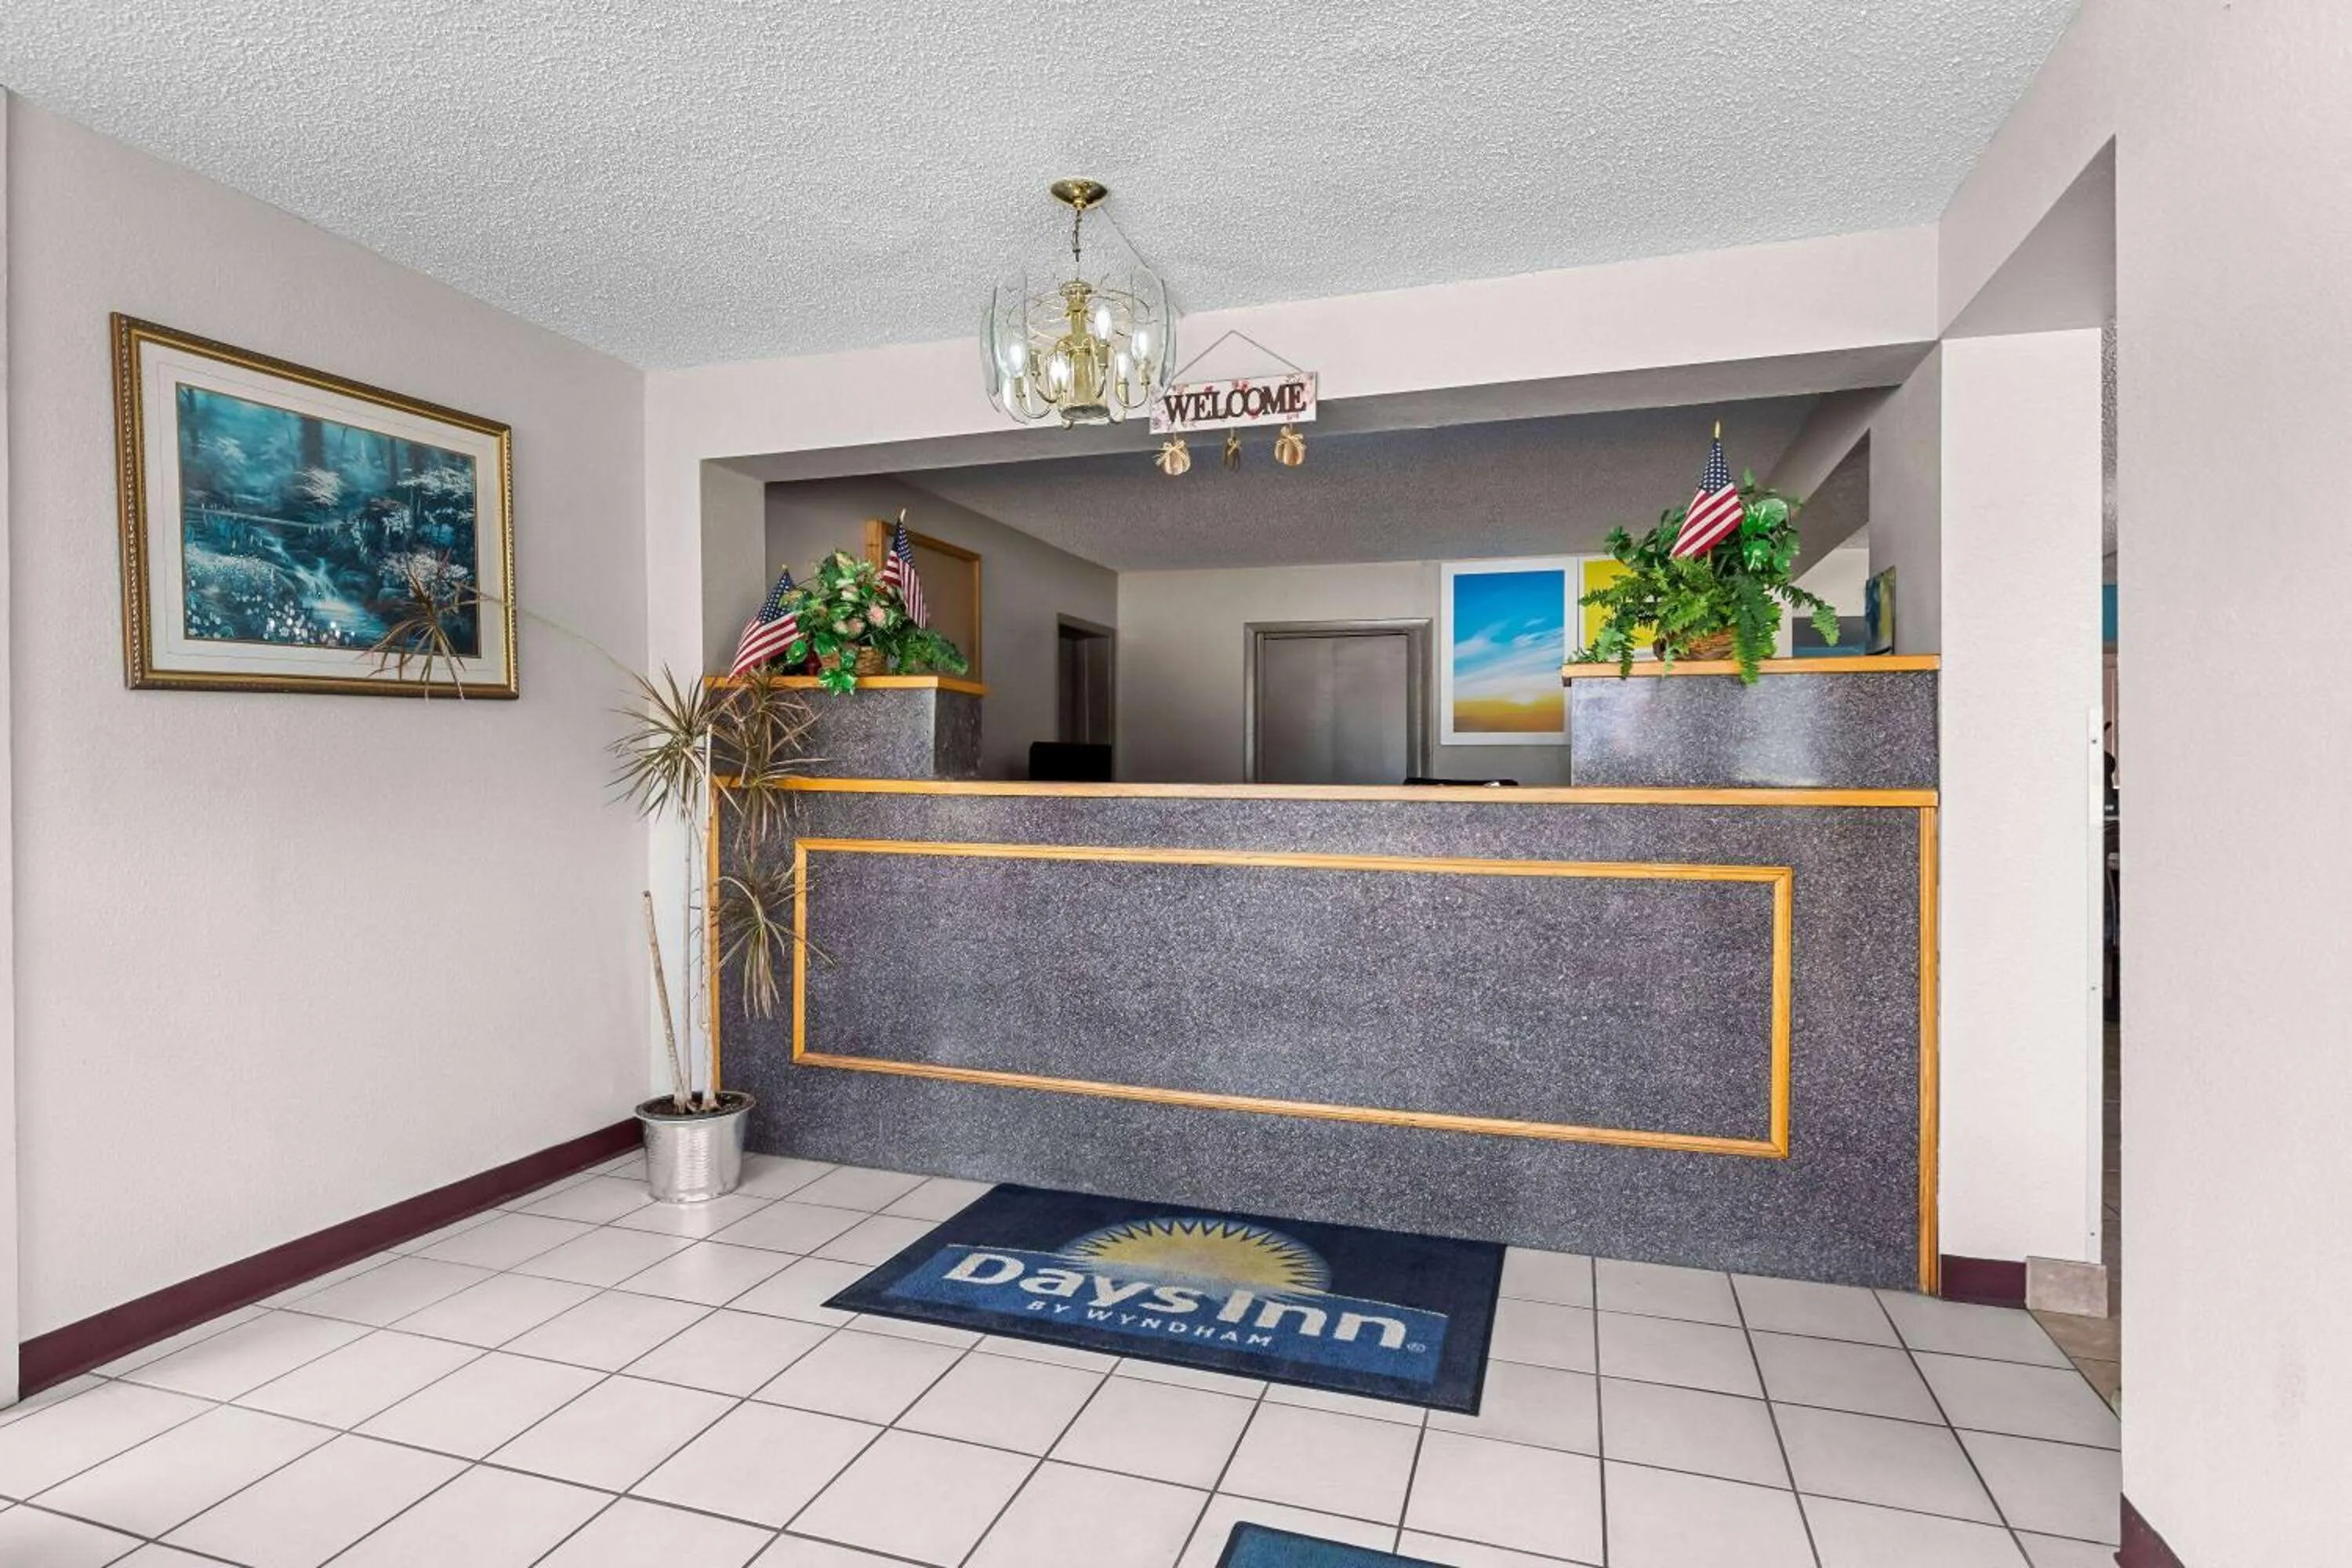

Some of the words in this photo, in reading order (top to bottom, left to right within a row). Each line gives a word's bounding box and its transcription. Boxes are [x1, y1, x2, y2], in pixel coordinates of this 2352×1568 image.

[1163, 383, 1307, 424] WELCOME
[941, 1253, 1204, 1313] Days
[1216, 1290, 1407, 1349] Inn
[1025, 1301, 1072, 1314] BY
[1087, 1308, 1273, 1348] WYNDHAM
